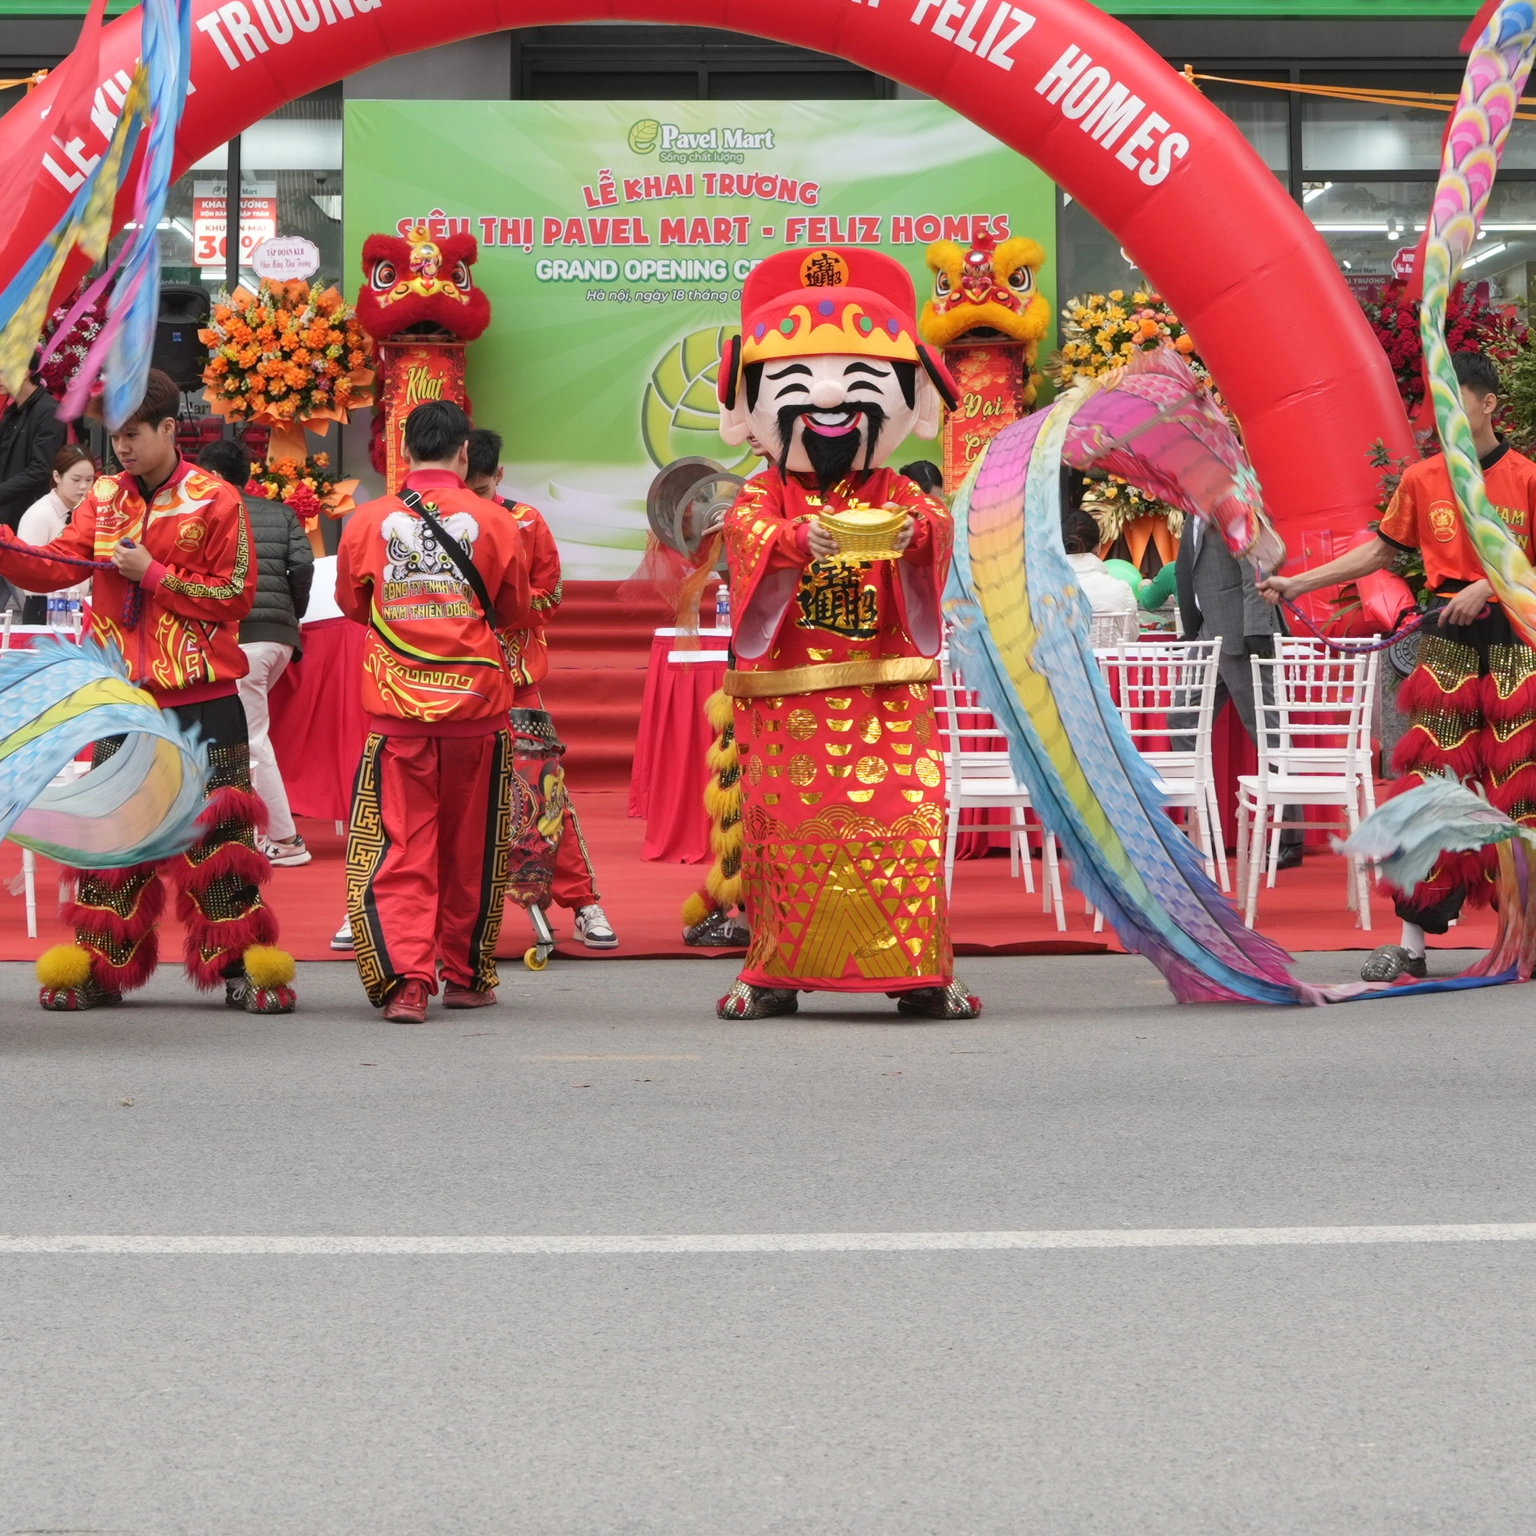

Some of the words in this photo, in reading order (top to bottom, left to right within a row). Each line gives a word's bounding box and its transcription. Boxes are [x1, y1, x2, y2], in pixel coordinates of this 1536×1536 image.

[1034, 43, 1190, 187] HOMES
[660, 123, 718, 150] Pavel
[722, 128, 775, 150] Mart
[659, 151, 687, 164] Sống
[688, 151, 712, 163] chất
[713, 151, 744, 164] lượng
[582, 168, 619, 210] LỄ
[623, 172, 694, 202] KHAI
[702, 171, 820, 206] TRƯƠNG
[201, 200, 227, 209] KHAI
[240, 199, 269, 209] ƯƠNG
[478, 216, 534, 254] THỊ
[542, 216, 651, 246] PAVEL
[659, 216, 751, 246] MART
[783, 216, 882, 245] FELIZ
[890, 214, 1011, 244] HOMES
[535, 259, 619, 282] GRAND
[624, 259, 729, 282] OPENING
[586, 289, 606, 302] Hà
[634, 289, 669, 304] ngày
[671, 289, 686, 301] 18
[687, 289, 728, 304] tháng
[406, 365, 445, 406] Khai
[963, 392, 1004, 422] Đại
[1495, 505, 1527, 528] AM
[382, 579, 408, 603] CÔNG
[410, 580, 423, 596] TY
[423, 579, 449, 595] TNHH
[382, 605, 408, 621] NAM
[410, 602, 444, 619] THIÊN
[446, 600, 479, 620] ĐƯỜNG
